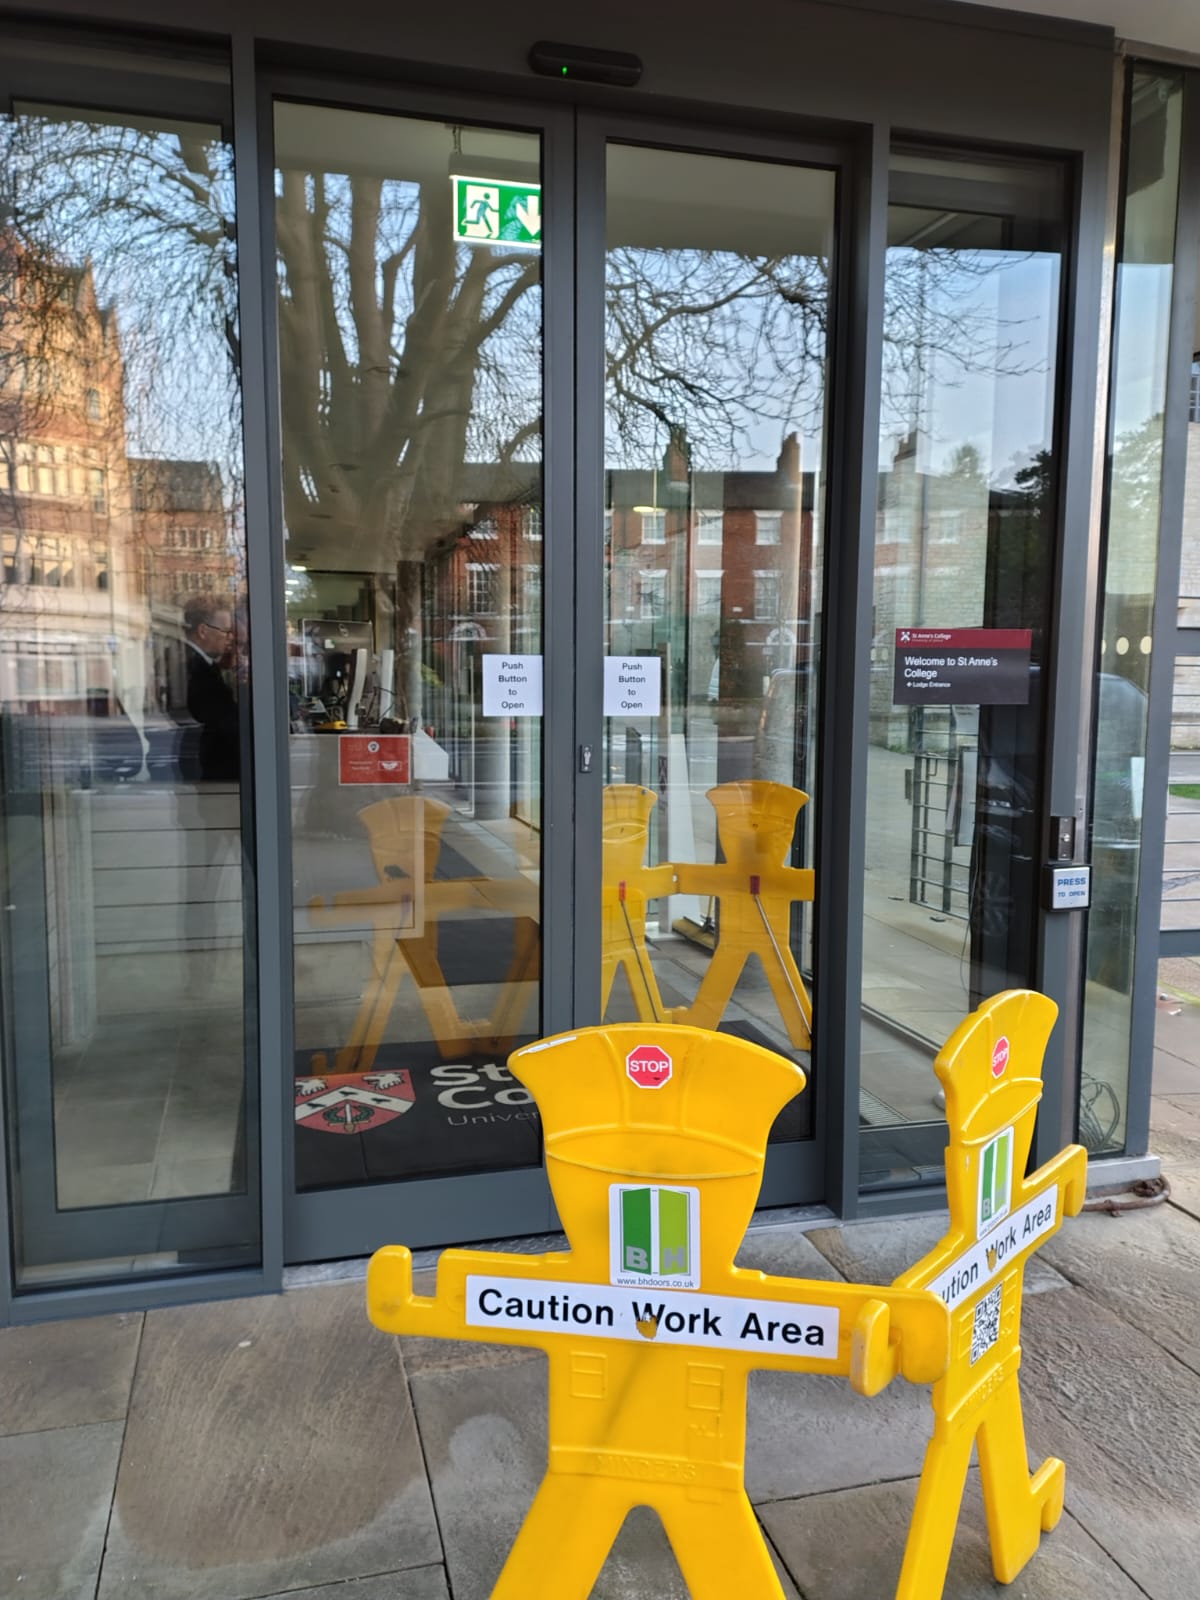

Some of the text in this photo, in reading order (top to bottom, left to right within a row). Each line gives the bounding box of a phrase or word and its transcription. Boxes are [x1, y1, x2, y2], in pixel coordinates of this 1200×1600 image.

[934, 632, 952, 641] College
[501, 661, 524, 670] Push
[622, 662, 643, 671] Push
[904, 656, 998, 667] Welcome to St Anne's
[498, 674, 527, 683] Button
[904, 667, 938, 680] College
[618, 675, 646, 683] Button
[912, 681, 928, 689] Lodge
[508, 688, 517, 696] to
[627, 688, 637, 696] to
[501, 701, 525, 710] Open
[620, 701, 643, 710] Open
[1057, 877, 1087, 887] PRESS
[992, 1047, 1008, 1068] STOP
[629, 1060, 669, 1073] STOP
[430, 1063, 514, 1086] St
[437, 1086, 537, 1110] Co
[447, 1111, 539, 1126] Univer
[625, 1245, 685, 1270] B H
[941, 1261, 979, 1304] ution
[985, 1226, 1017, 1265] Work
[1022, 1203, 1052, 1240] Area
[616, 1277, 695, 1288] www.bhdoors.co.uk
[478, 1288, 825, 1346] Caution Work Area
